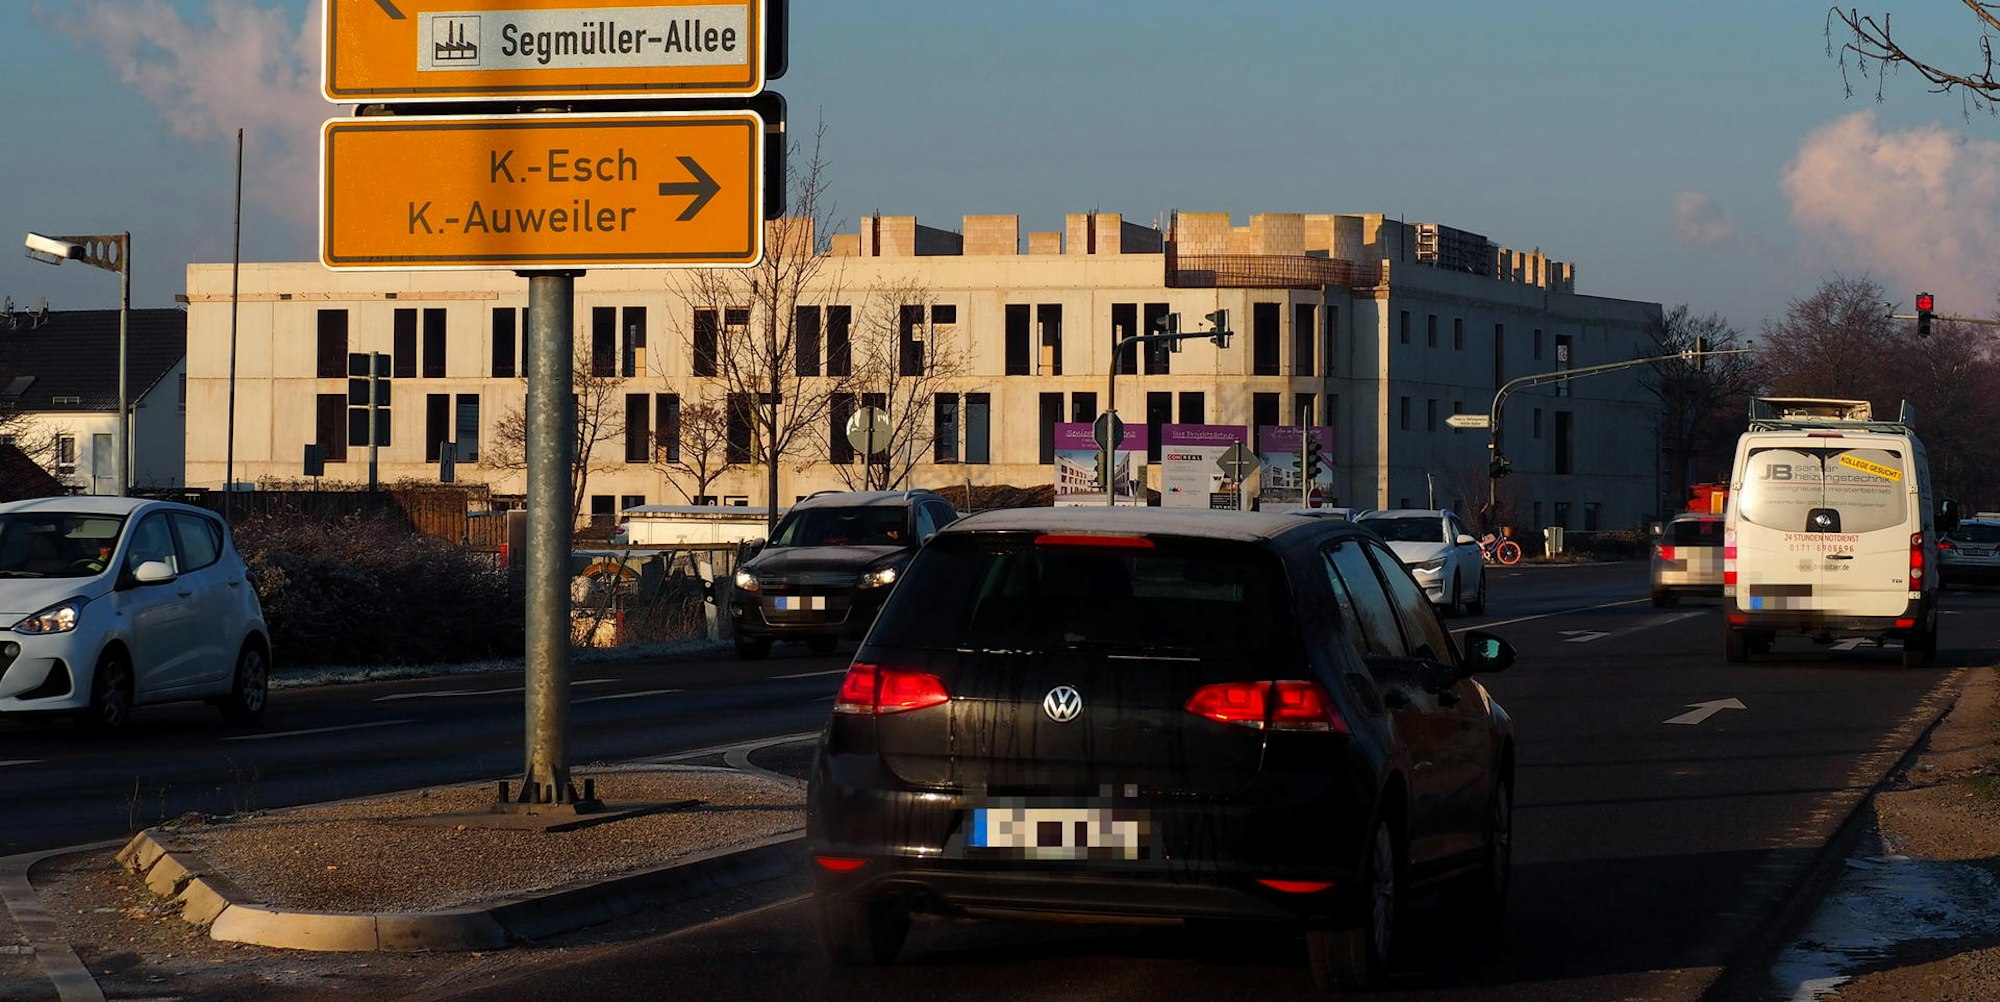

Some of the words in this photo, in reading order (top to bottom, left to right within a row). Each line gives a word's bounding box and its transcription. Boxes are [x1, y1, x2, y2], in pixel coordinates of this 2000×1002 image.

[501, 19, 736, 65] Segmüller-Allee
[490, 148, 637, 183] K.-Esch
[408, 199, 637, 234] K.-Auweiler
[1760, 464, 1793, 481] JB
[1841, 456, 1869, 470] KOLLEGE
[1869, 464, 1897, 478] GESUCHT
[1784, 533, 1792, 541] 24
[1793, 533, 1823, 542] STUNDEN
[1824, 534, 1859, 543] NOTDIENST
